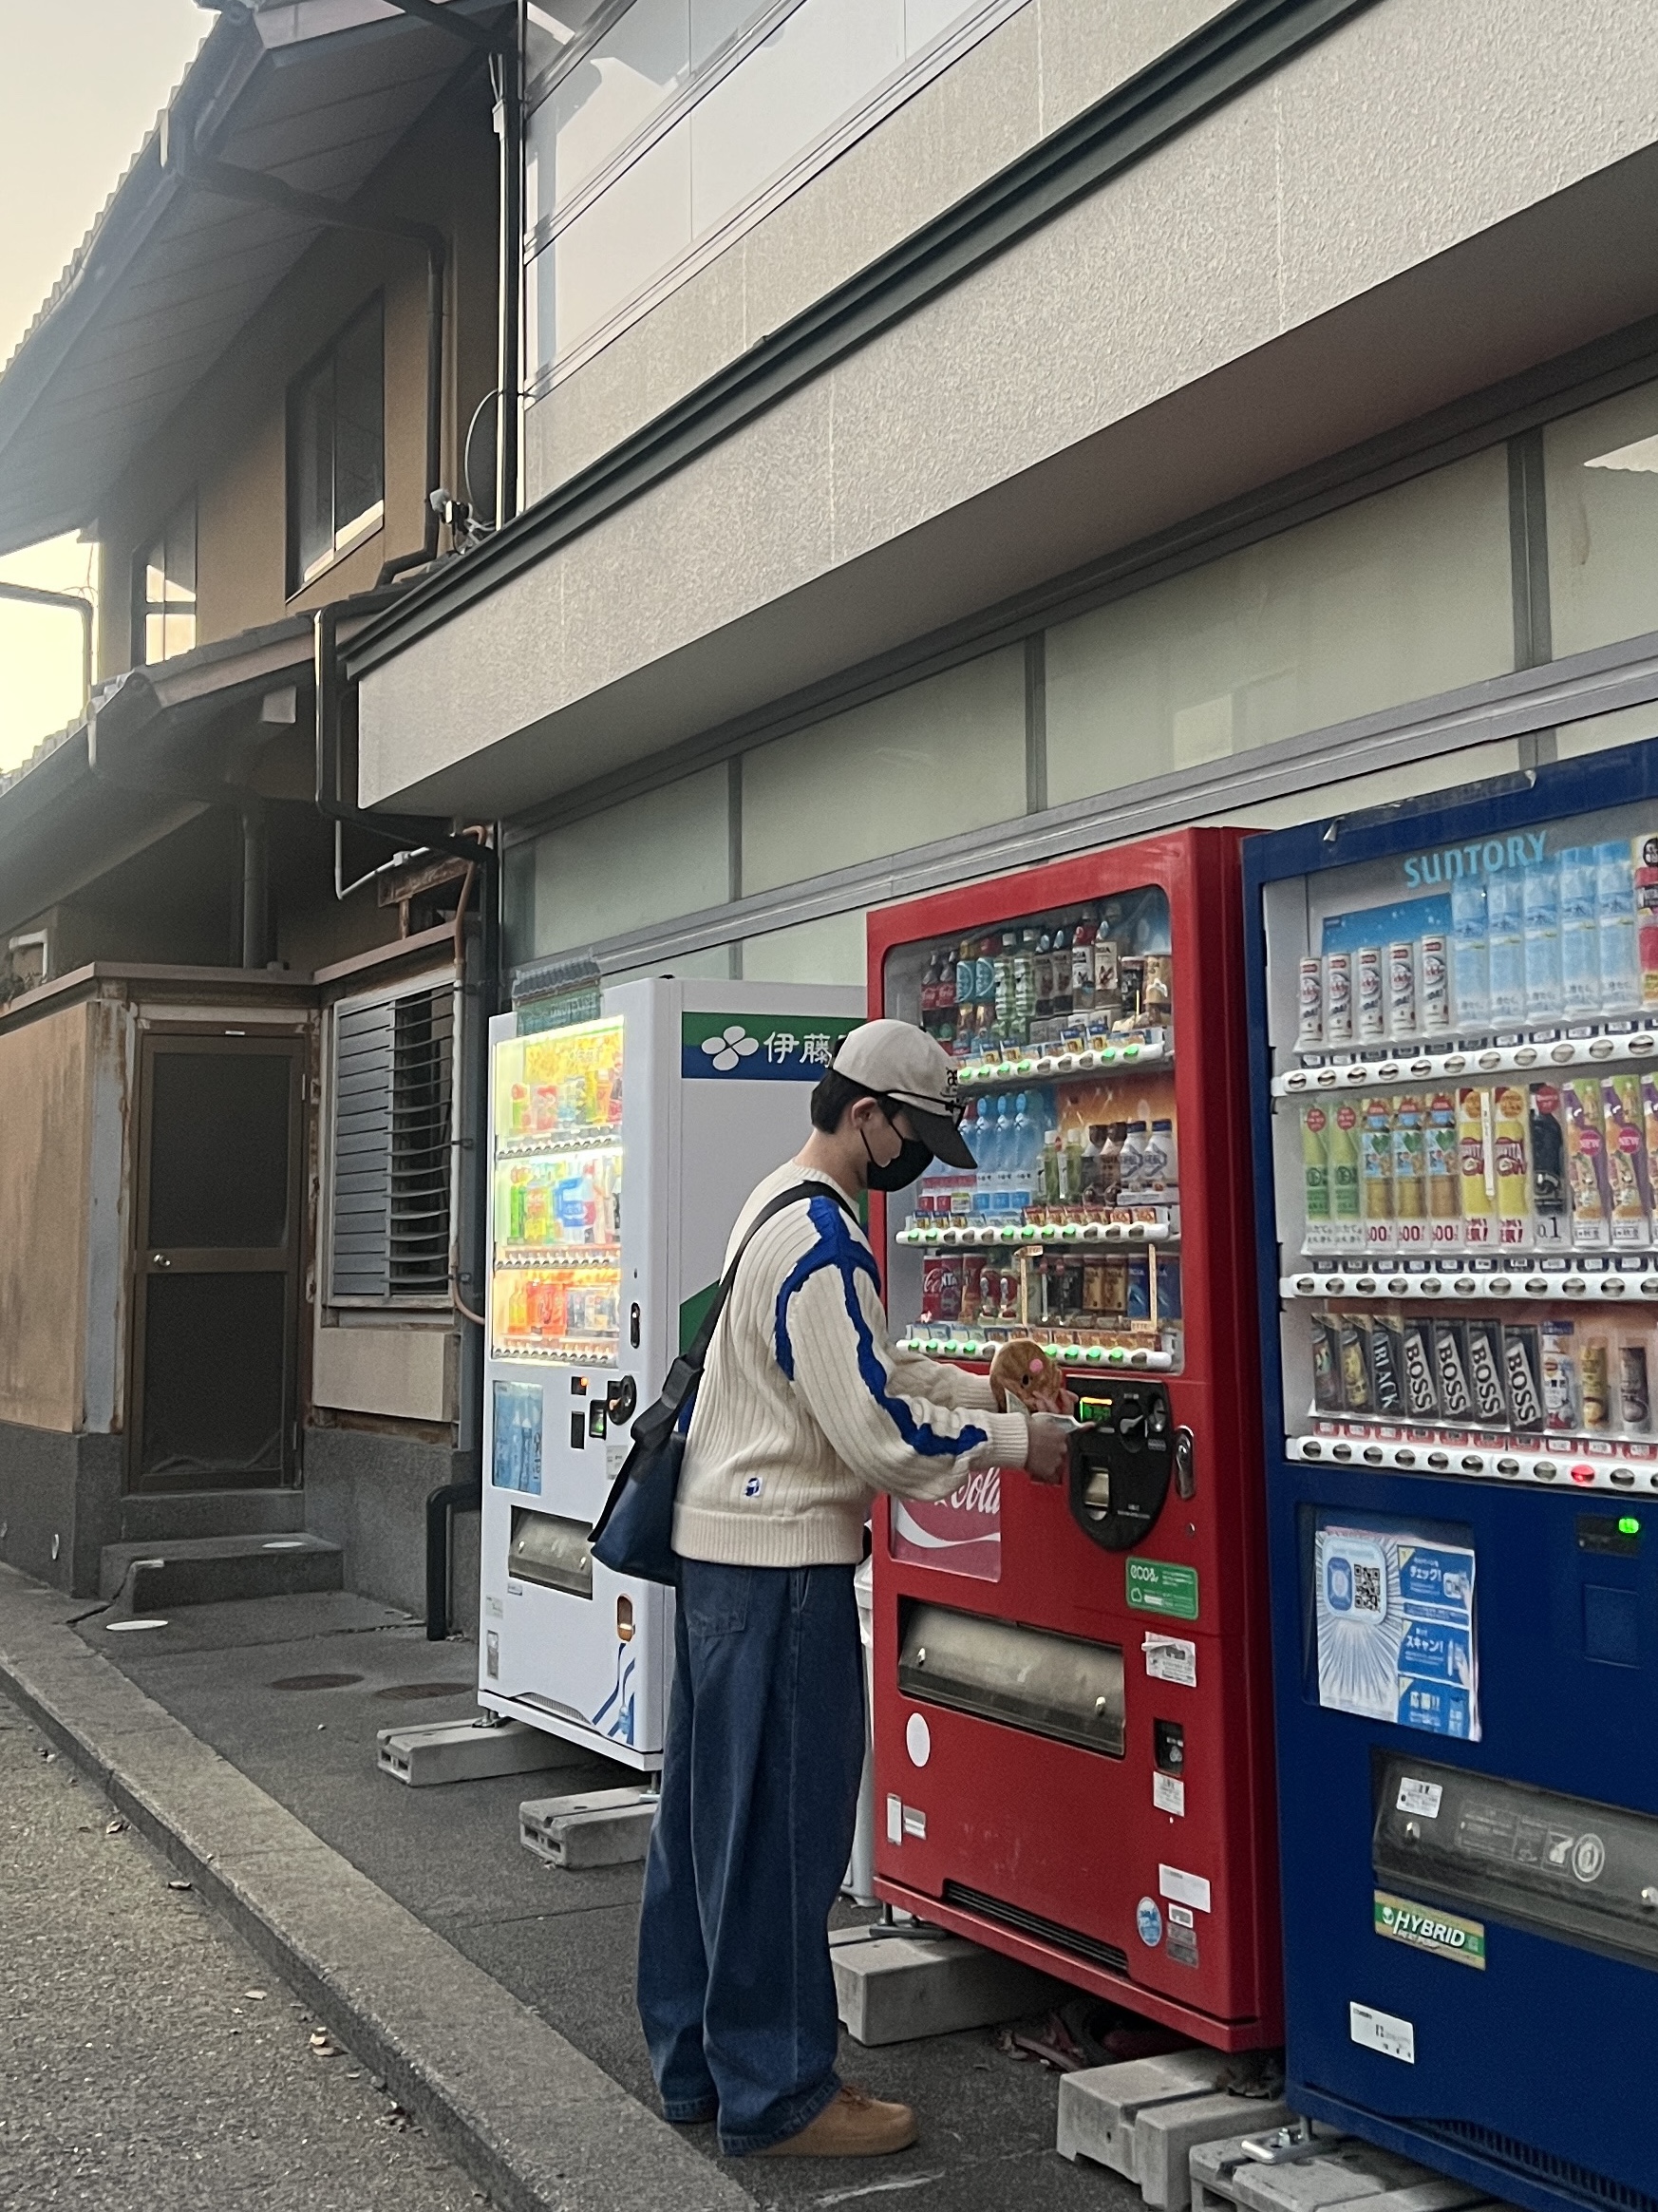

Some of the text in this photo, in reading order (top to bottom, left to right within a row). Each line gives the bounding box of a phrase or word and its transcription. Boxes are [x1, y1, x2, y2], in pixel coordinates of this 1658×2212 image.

[1404, 829, 1547, 889] SUNTORY
[763, 1030, 847, 1068] 伊藤
[1373, 1340, 1400, 1409] BLACK
[1405, 1342, 1433, 1409] BOSS
[1438, 1342, 1467, 1411] BOSS
[1472, 1345, 1501, 1414] BOSS
[1507, 1352, 1537, 1422] BOSS
[1392, 1910, 1465, 1947] HYBRID
